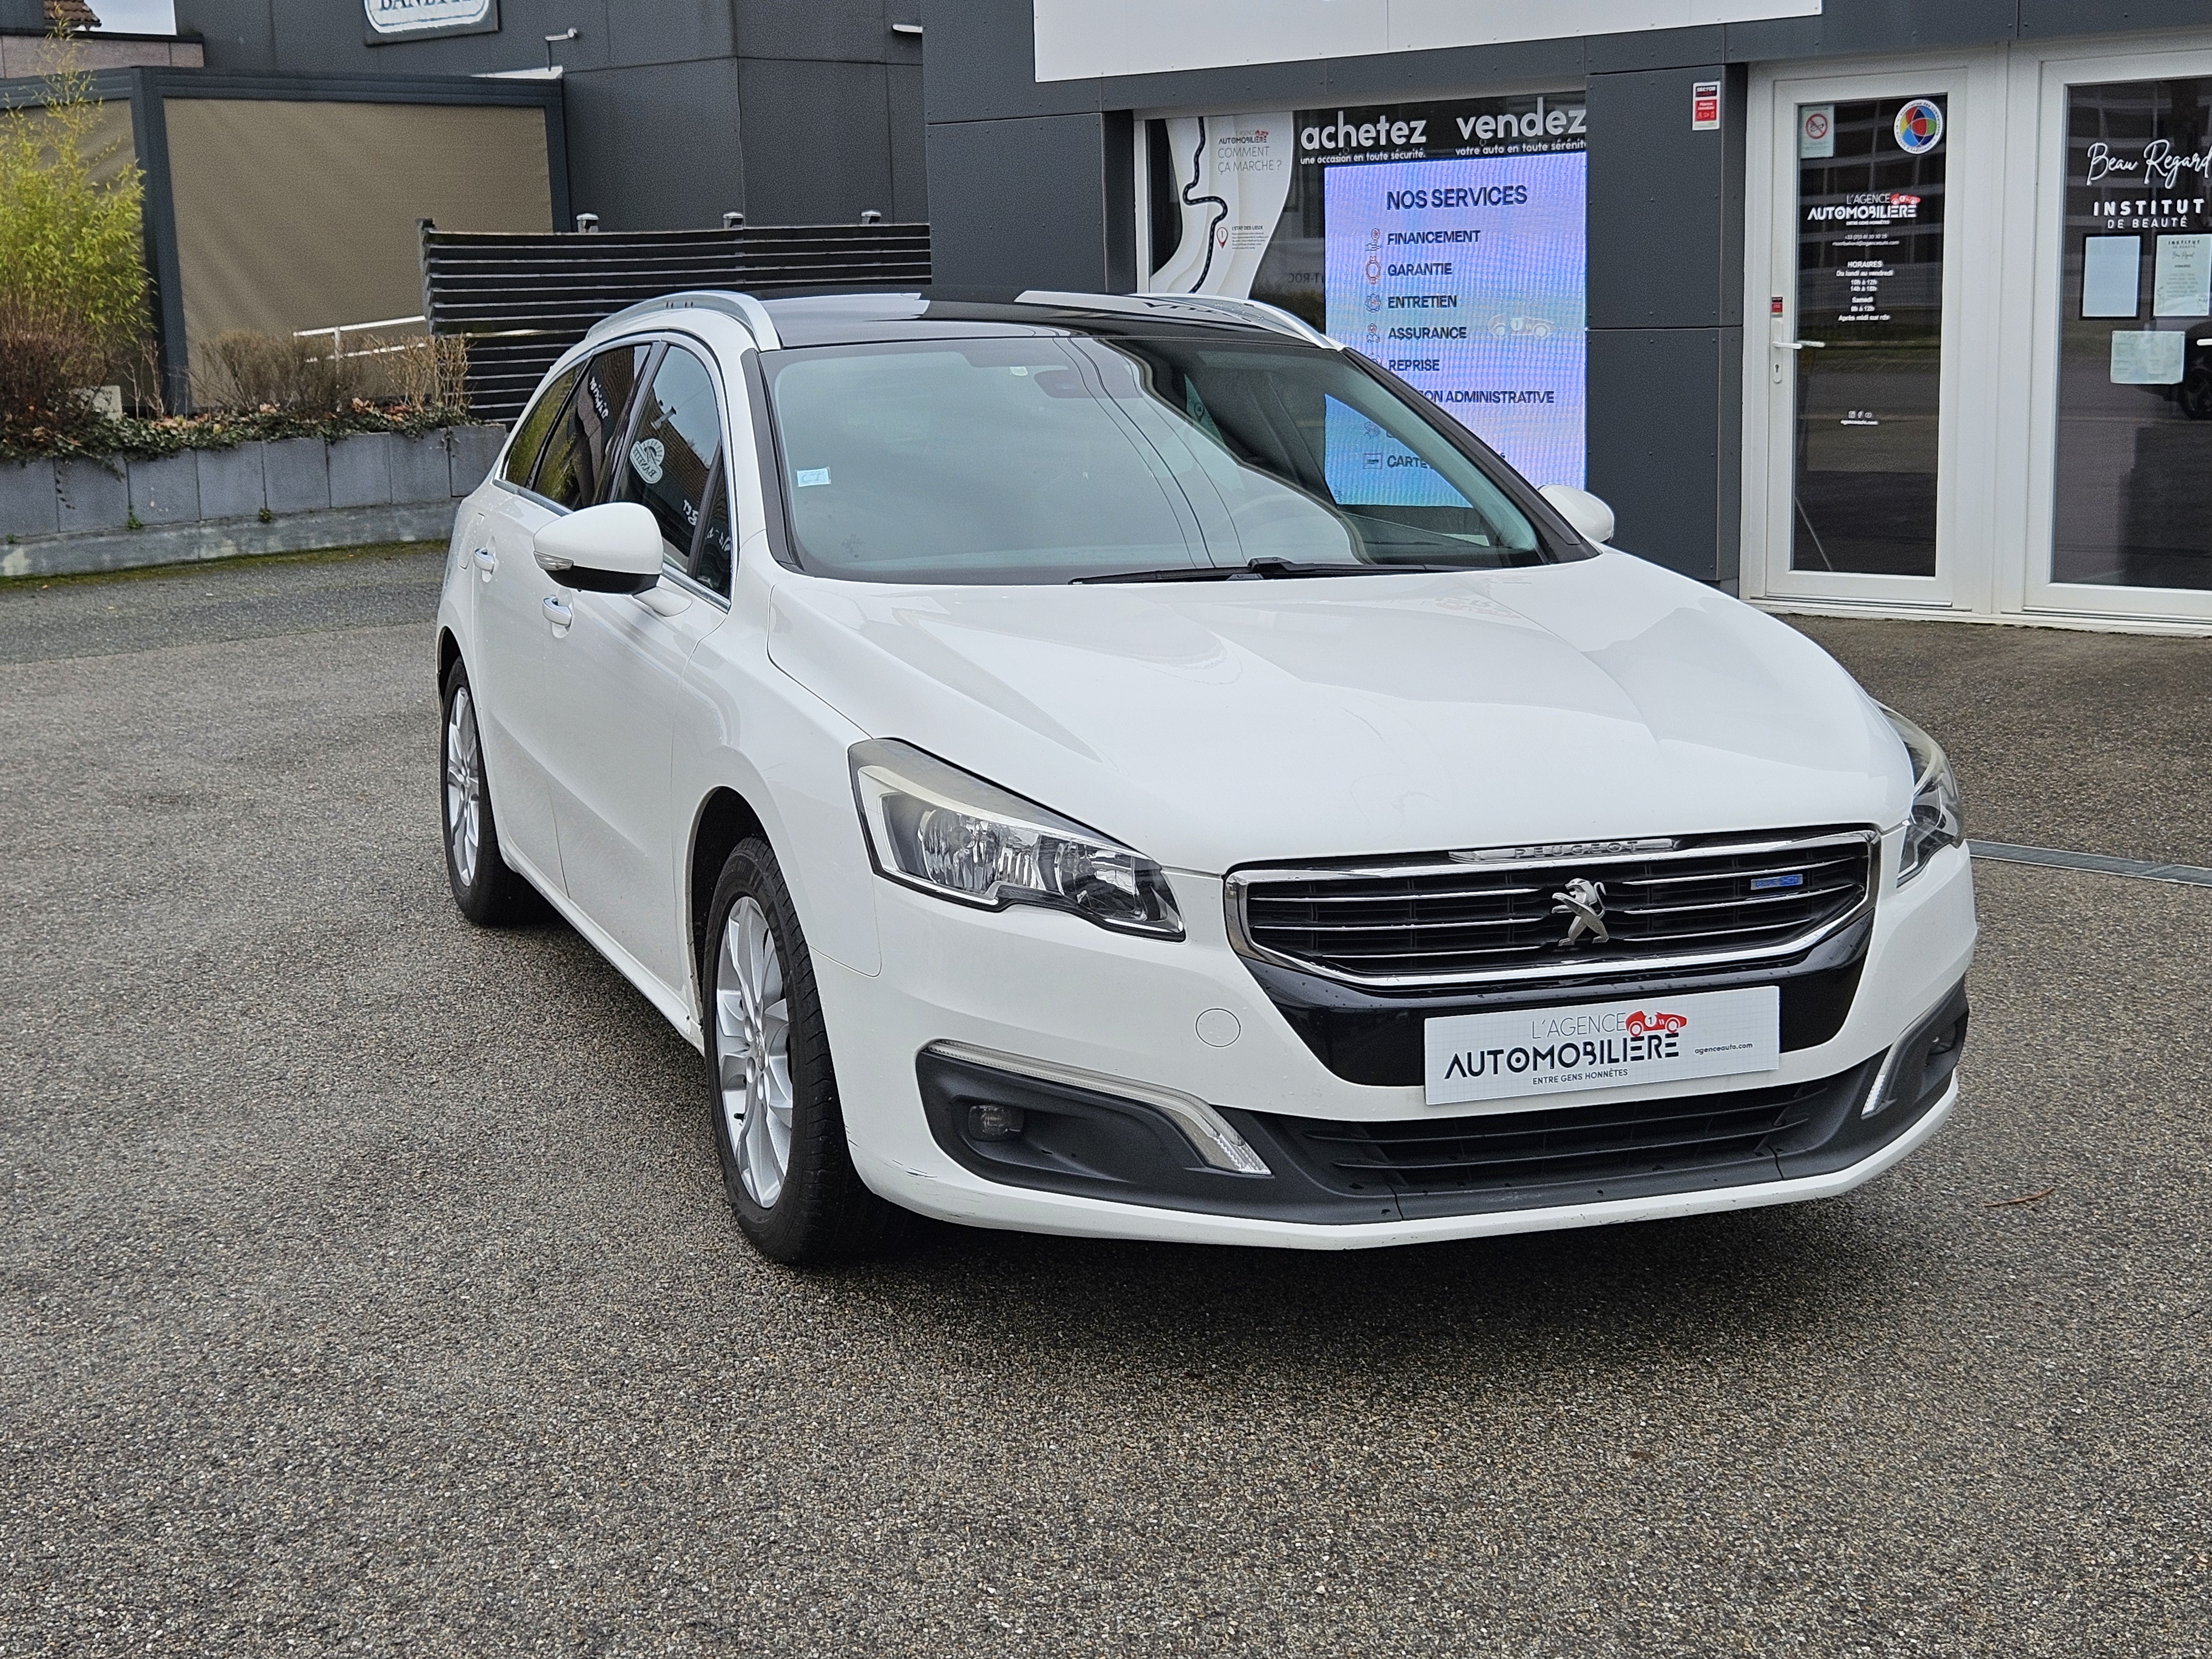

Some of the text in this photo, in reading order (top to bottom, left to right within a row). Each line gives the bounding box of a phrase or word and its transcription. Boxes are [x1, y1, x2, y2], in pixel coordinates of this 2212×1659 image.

[1456, 97, 1586, 140] vendez
[1301, 111, 1427, 150] achetez
[1218, 147, 1270, 158] COMMENT
[1455, 146, 1480, 156] votre
[1483, 144, 1504, 154] auto
[1522, 143, 1548, 152] toute
[1551, 138, 1586, 150] sérénit
[1317, 152, 1351, 163] occasion
[1366, 152, 1388, 161] toute
[1391, 147, 1426, 159] sécurité.
[1218, 160, 1282, 175] ÇA MARCHE ?
[2086, 139, 2212, 189] Beau Regard
[1387, 185, 1527, 210] NOS SERVICES
[1846, 194, 1890, 205] L'AGENCE
[2094, 199, 2205, 216] INSTITUT
[2107, 219, 2125, 229] DE
[1387, 230, 1481, 245] FINANCEMENT
[1387, 263, 1452, 276] GARANTIE
[1387, 295, 1457, 309] ENTRETIEN
[1388, 327, 1467, 340] ASSURANCE
[1389, 359, 1440, 371] REPRISE
[1446, 390, 1554, 404] ADMINISTRATIVE
[1514, 841, 1638, 859] PEUGEOT
[1531, 1012, 1652, 1039] L'AGENCE 1
[1694, 1043, 1753, 1055] agenceauto.com
[1532, 1068, 1628, 1085] ENTRE GENS HONNÊTES
